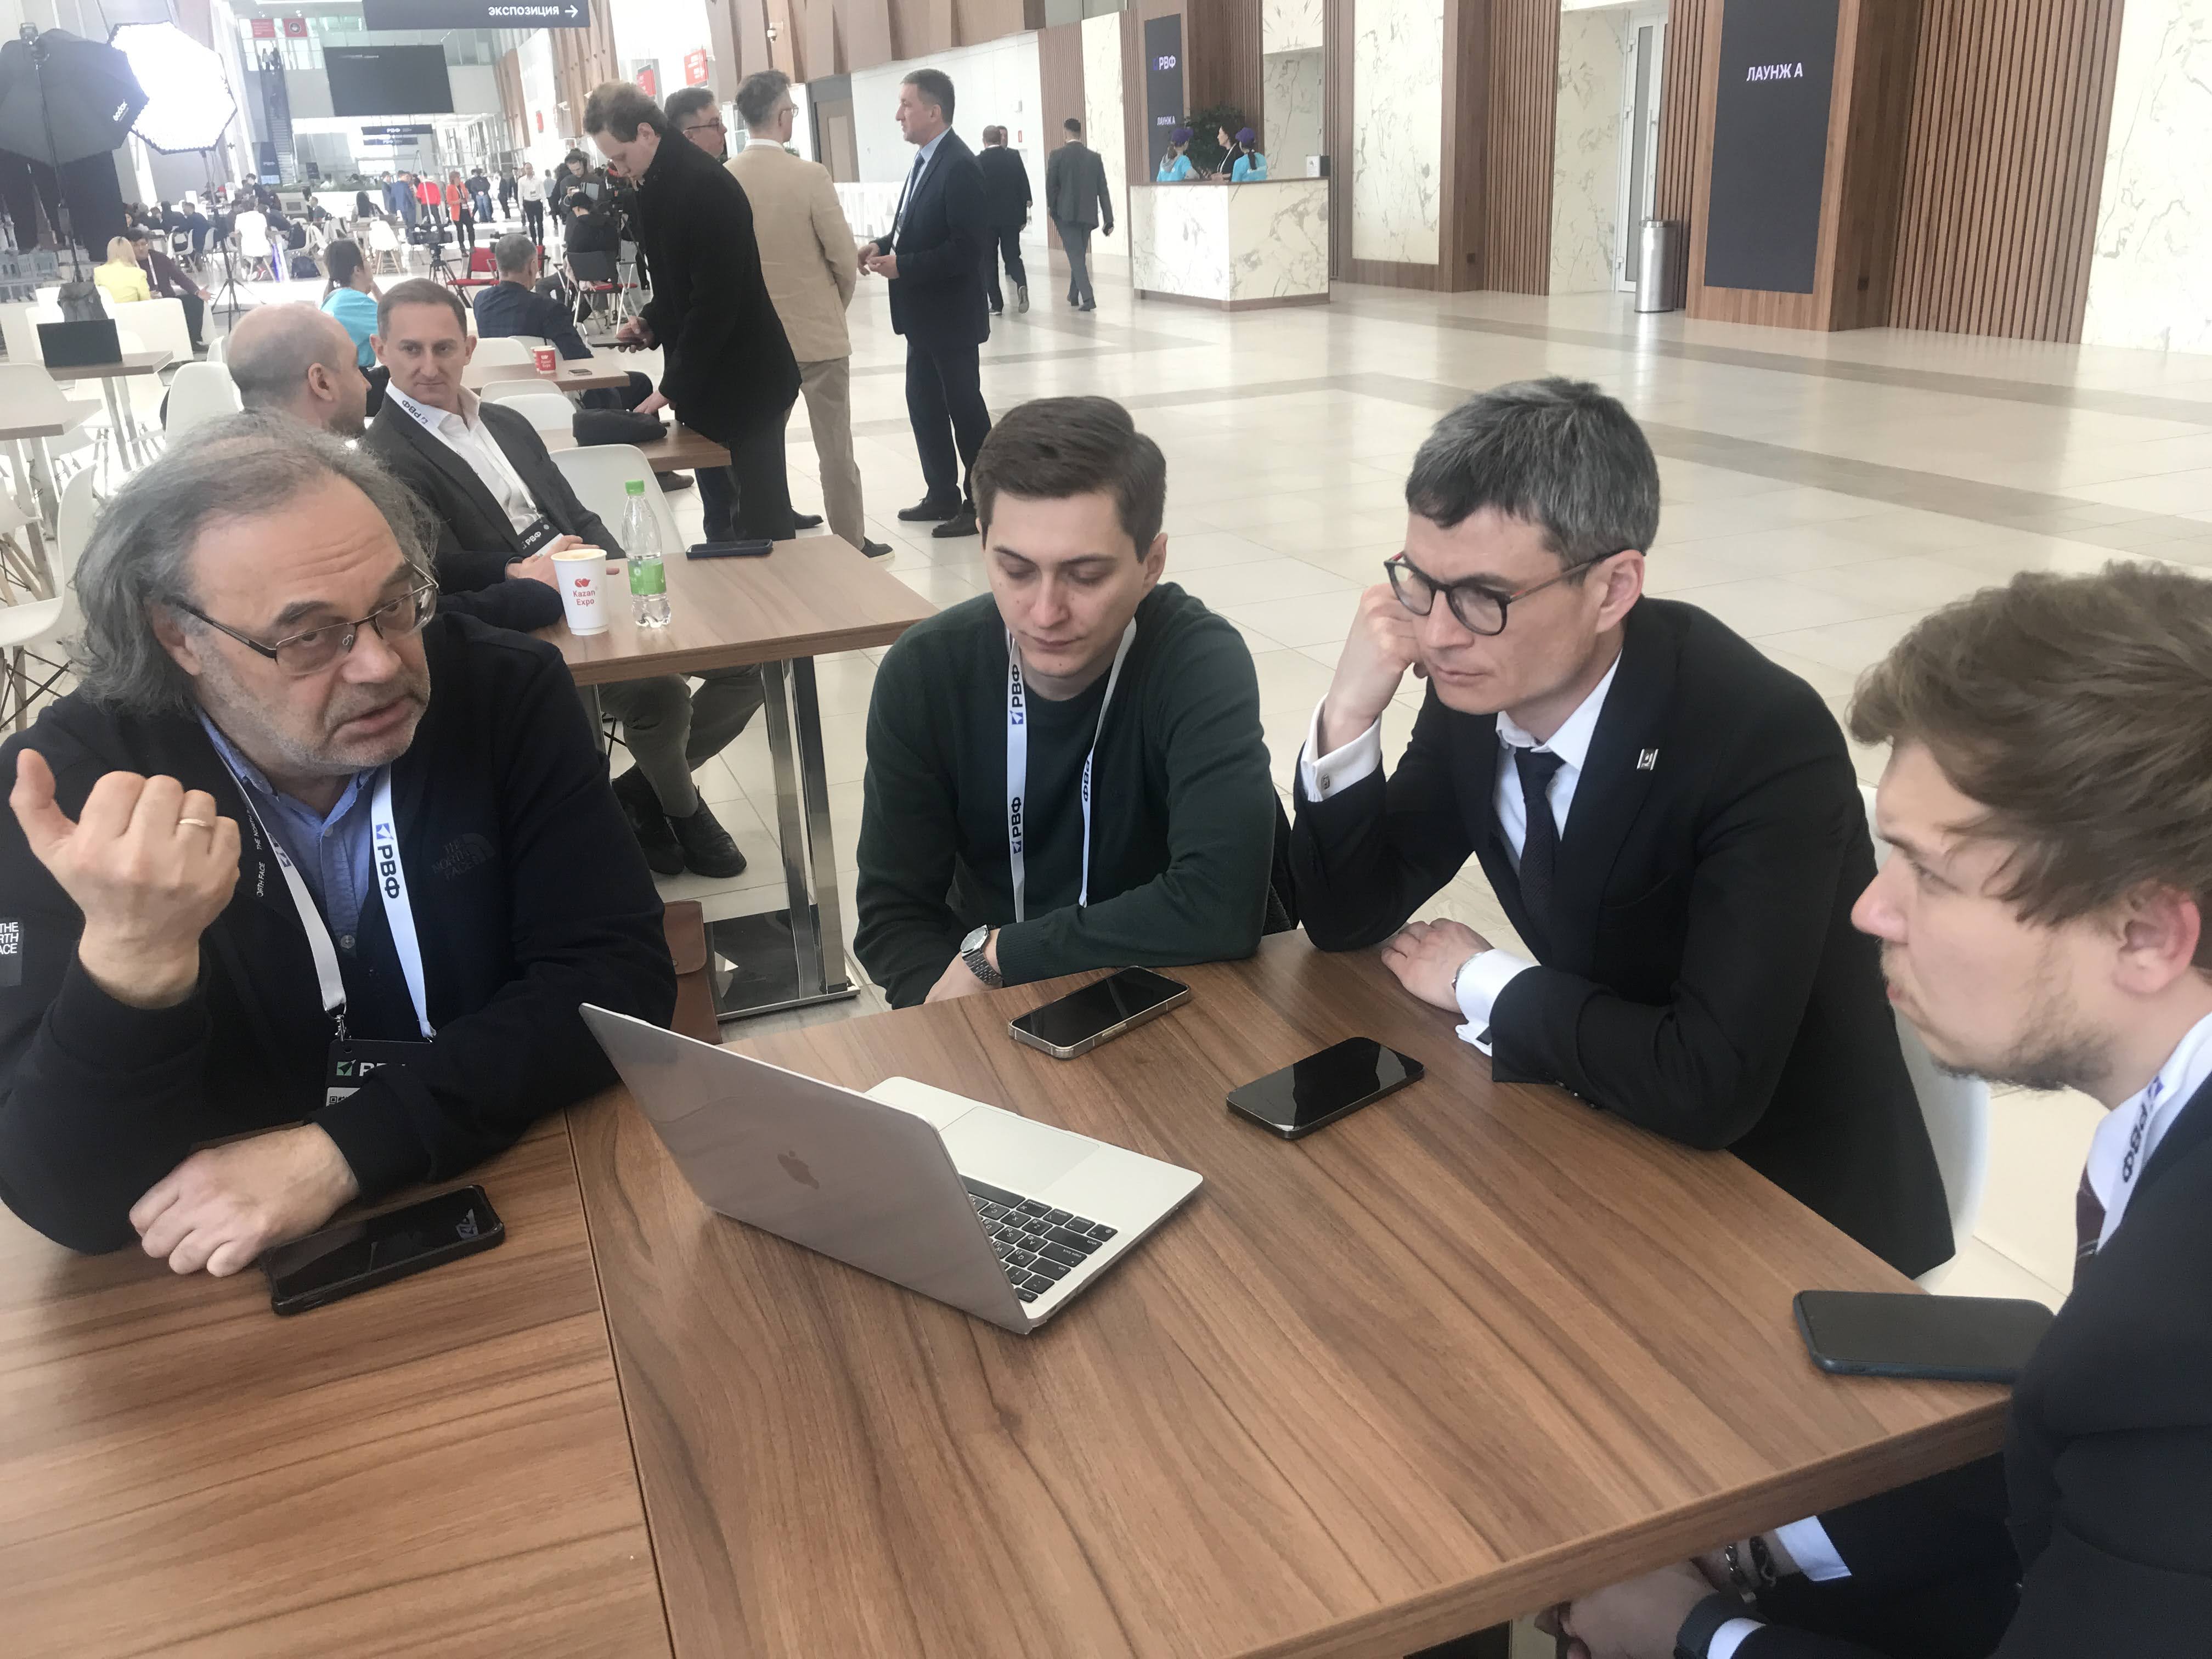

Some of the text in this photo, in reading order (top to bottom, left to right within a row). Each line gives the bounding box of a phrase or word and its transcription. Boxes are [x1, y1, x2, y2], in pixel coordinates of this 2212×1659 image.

[488, 6, 560, 17] ЭКСПОЗИЦИЯ
[1159, 55, 1176, 70] РВФ
[1746, 62, 1803, 81] ЛАУНЖ А
[402, 400, 421, 418] РВФ
[525, 531, 541, 545] РВФ
[576, 599, 595, 607] Expo
[1012, 664, 1023, 708] РВФ
[1011, 797, 1022, 838] РВФ
[377, 844, 400, 899] РВФ
[0, 922, 19, 934] THE
[2122, 1102, 2148, 1183] РВФ
